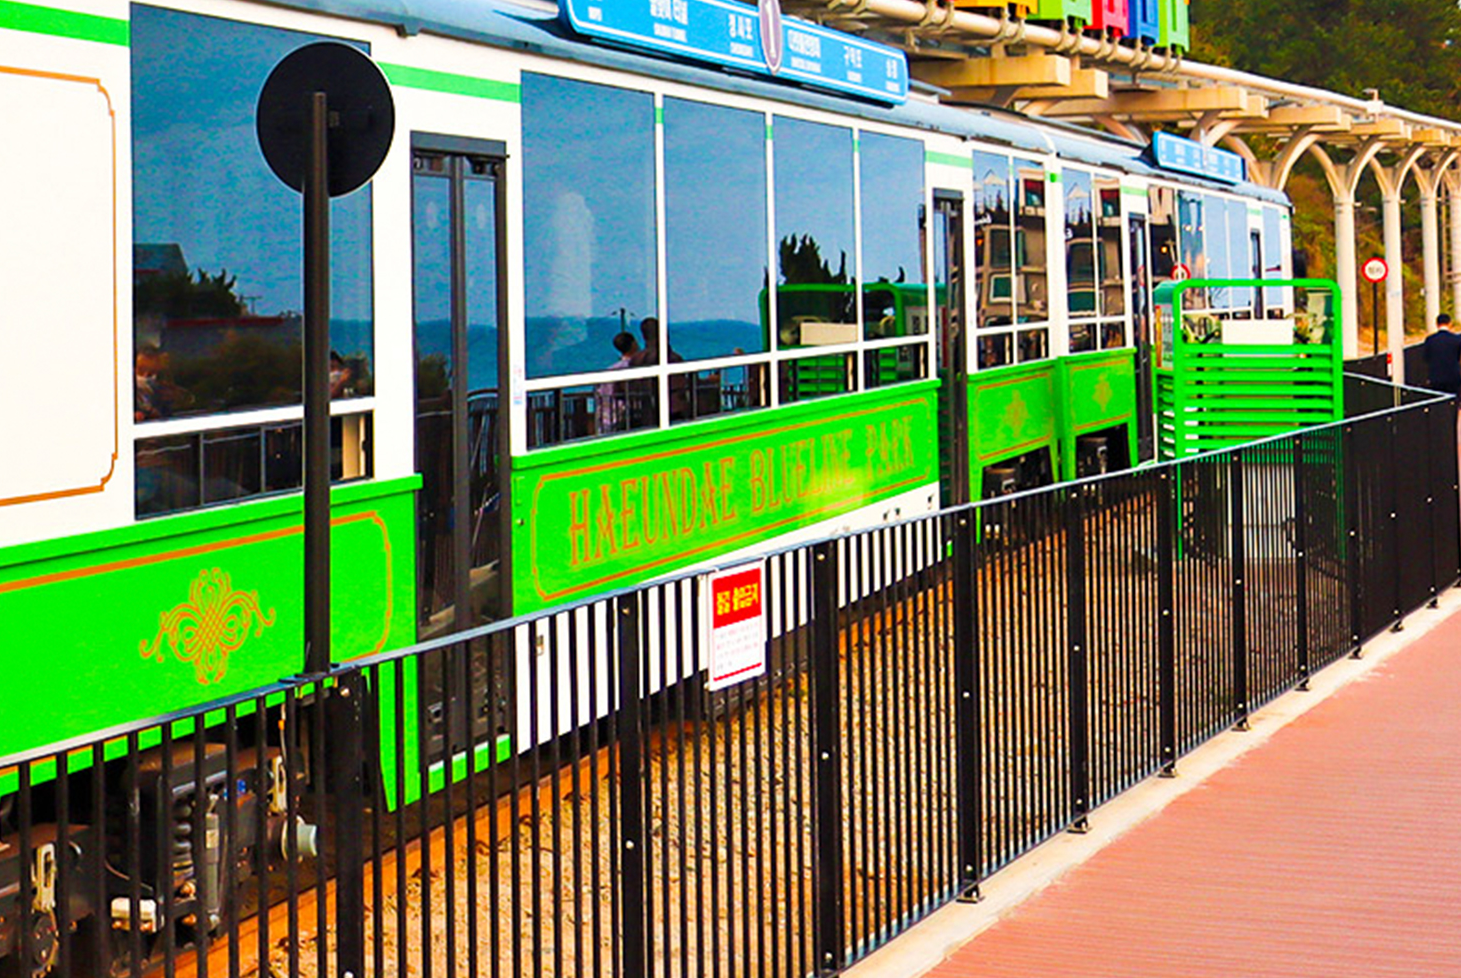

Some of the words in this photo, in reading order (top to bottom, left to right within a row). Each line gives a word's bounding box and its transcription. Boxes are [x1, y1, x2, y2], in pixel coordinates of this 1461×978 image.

[765, 0, 777, 58] 1
[569, 457, 736, 567] HAEUNDAE
[750, 428, 856, 514] BLUELINE
[865, 415, 915, 480] PARK
